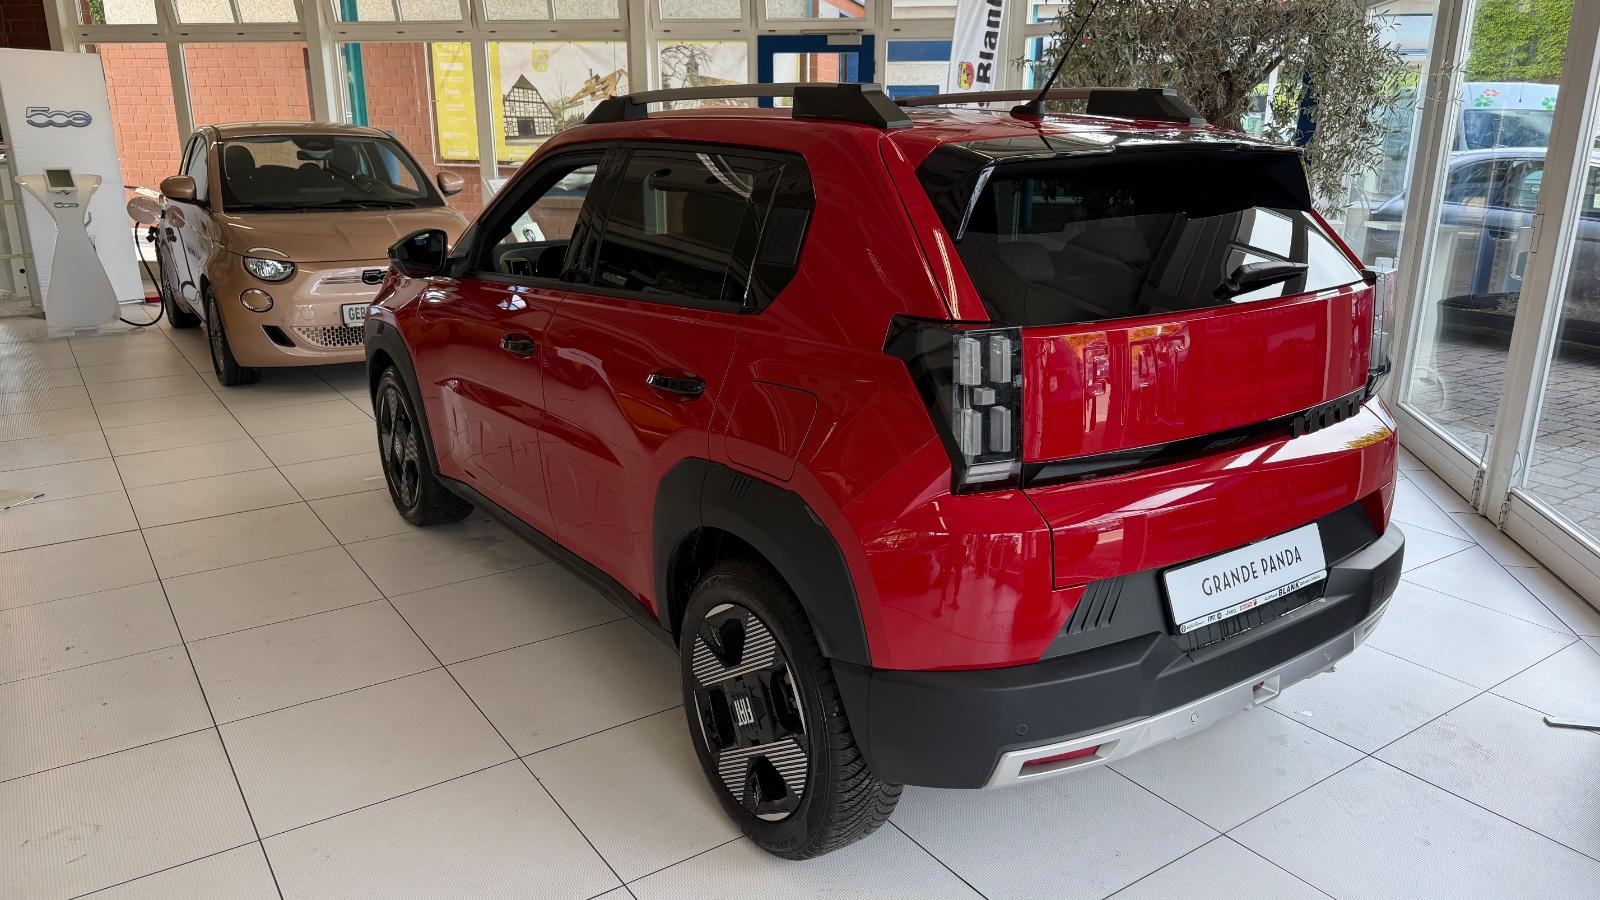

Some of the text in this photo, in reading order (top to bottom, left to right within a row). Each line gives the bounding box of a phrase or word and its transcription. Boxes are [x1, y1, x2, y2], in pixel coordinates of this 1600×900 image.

[348, 306, 369, 321] GEB
[1202, 545, 1302, 596] GRANDE PANDA
[1278, 580, 1300, 597] BLANK
